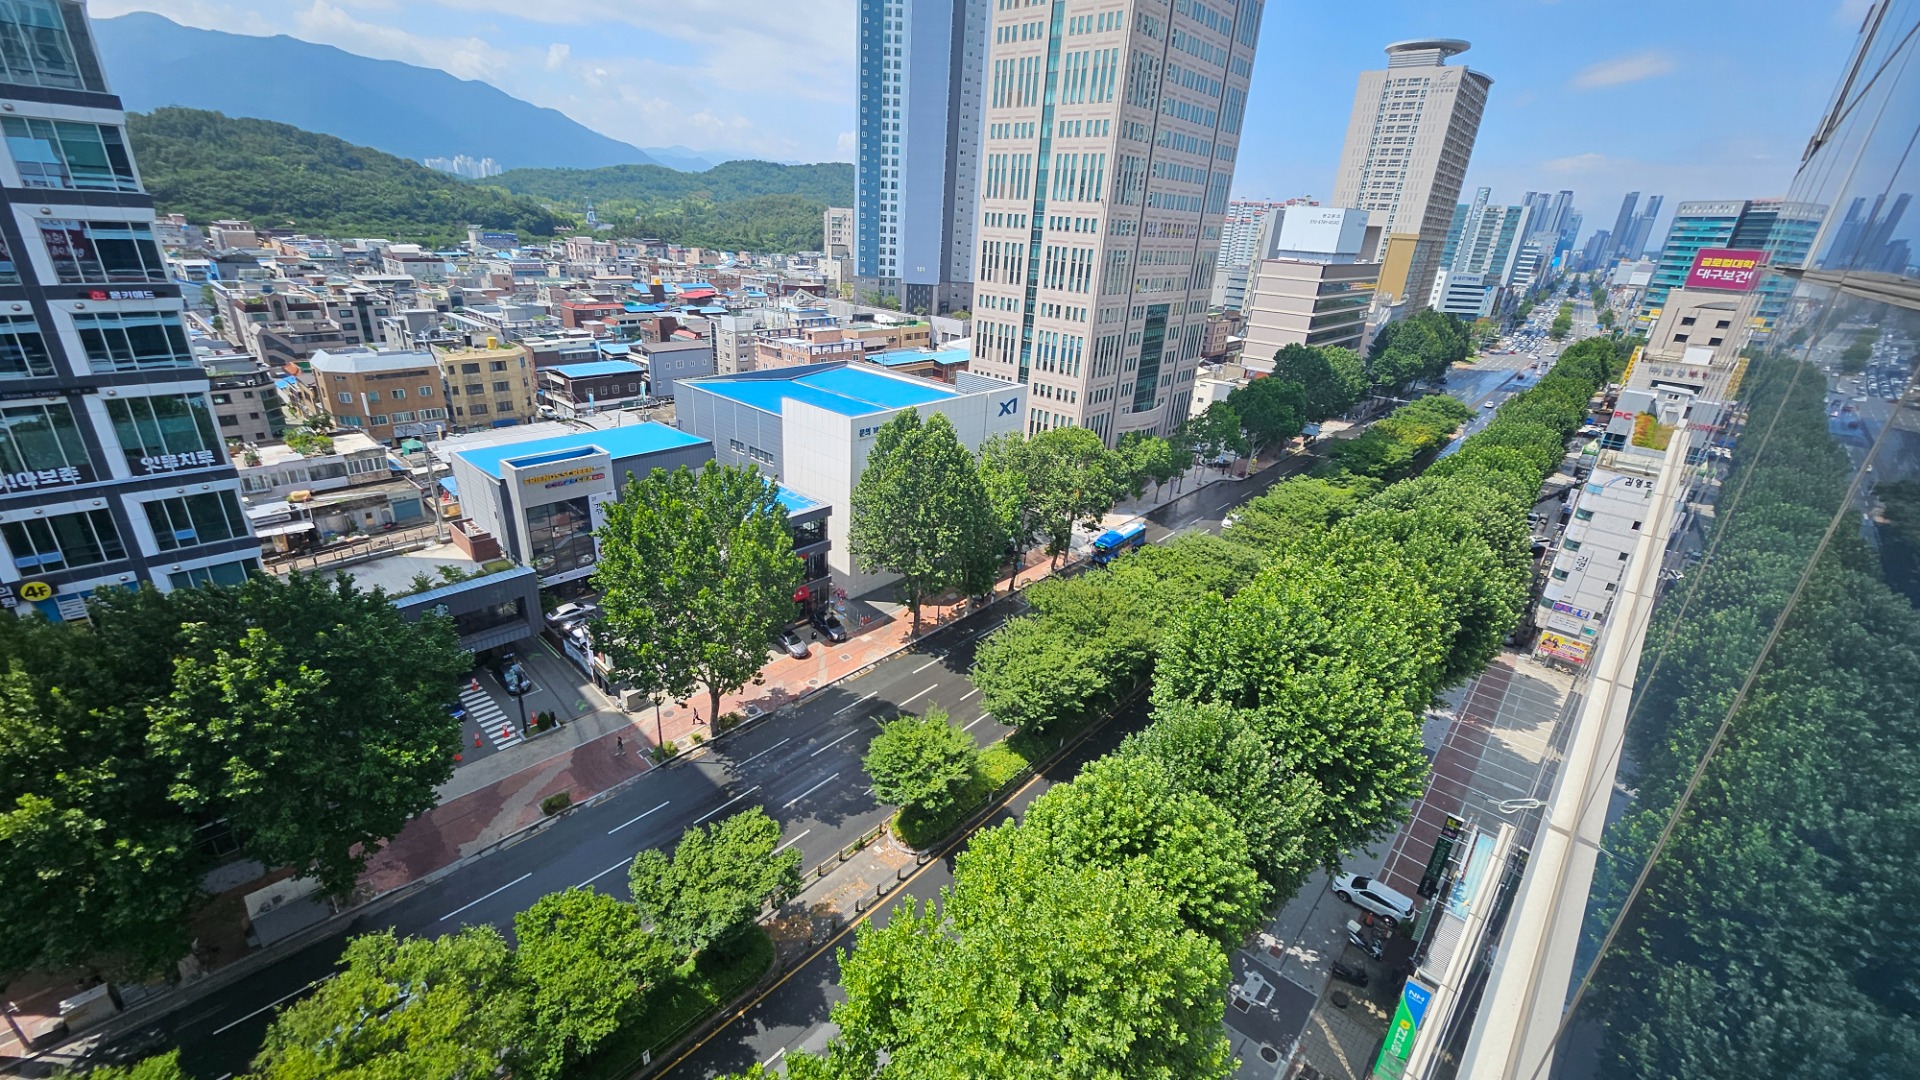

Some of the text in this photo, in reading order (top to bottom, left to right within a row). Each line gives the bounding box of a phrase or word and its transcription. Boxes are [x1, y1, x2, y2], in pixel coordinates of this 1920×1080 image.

[1613, 410, 1634, 421] PC
[140, 449, 216, 471] 잇몸치료
[24, 585, 48, 598] 4F
